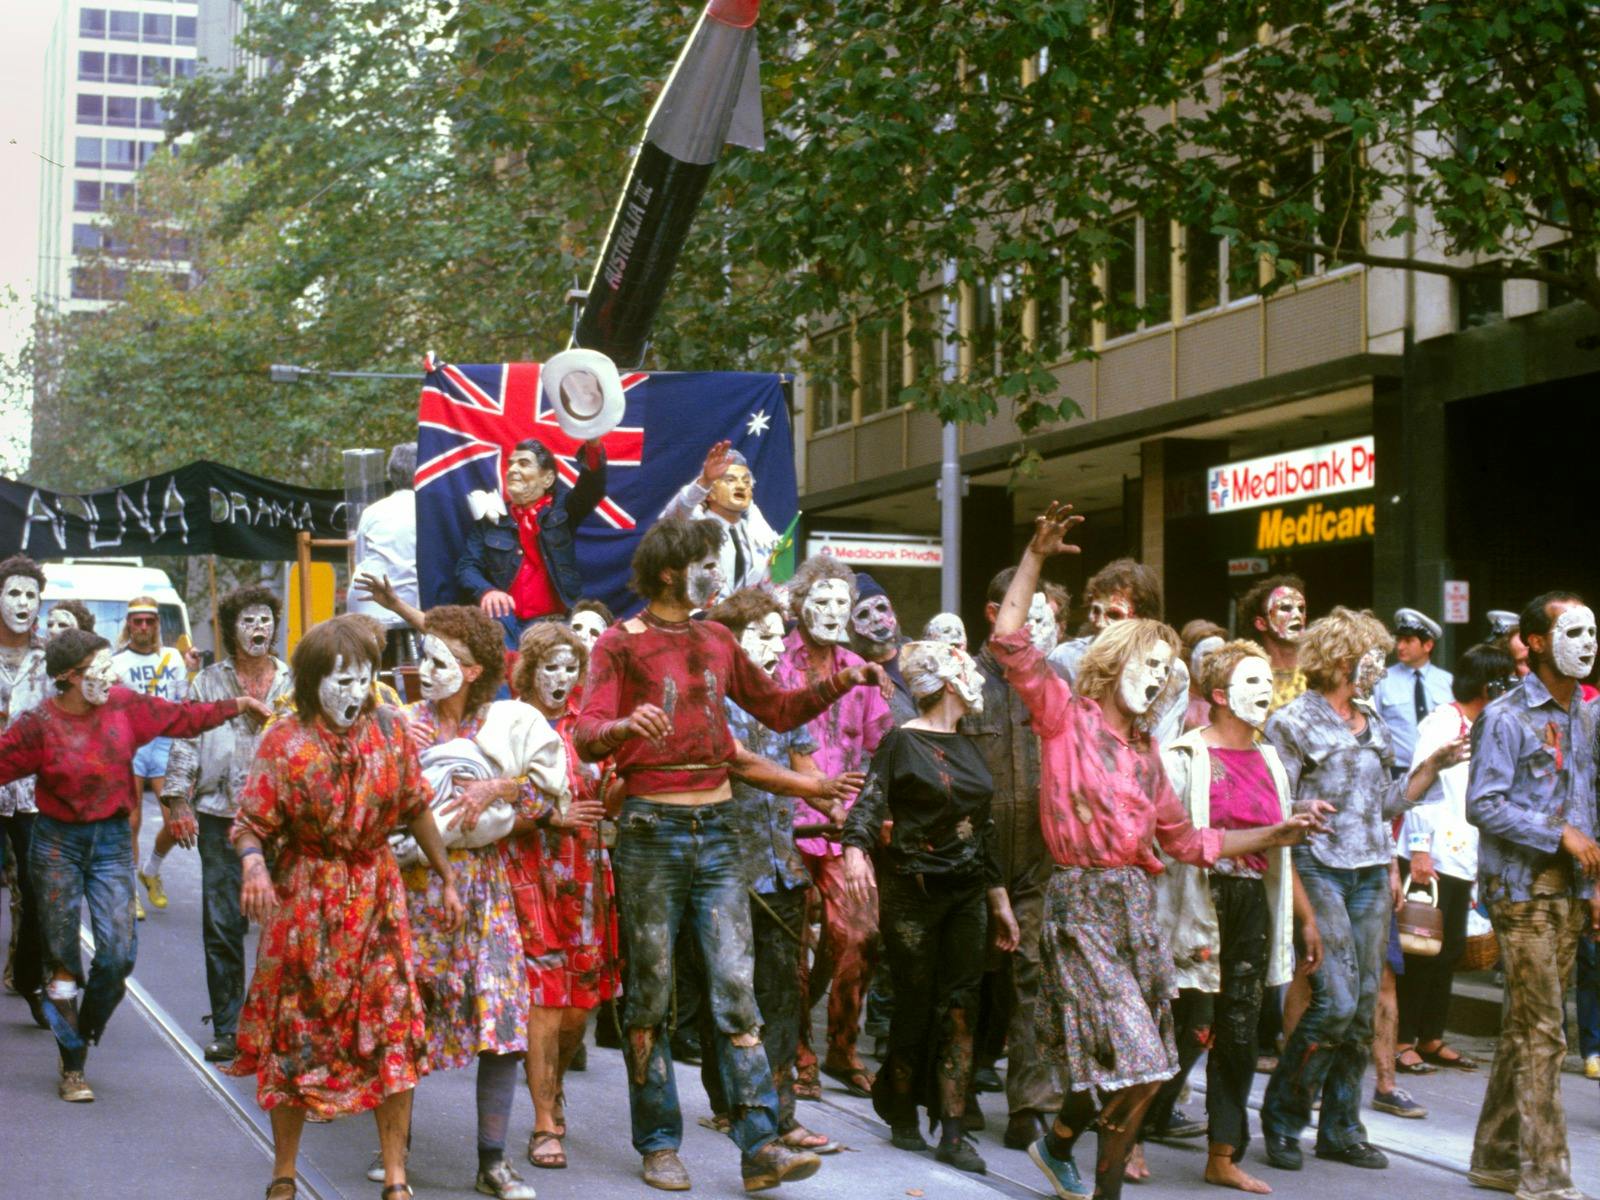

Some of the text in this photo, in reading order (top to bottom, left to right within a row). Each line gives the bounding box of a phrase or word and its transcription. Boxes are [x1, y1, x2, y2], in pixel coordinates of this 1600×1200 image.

[604, 202, 646, 291] AUSTRALIA
[1232, 450, 1347, 504] Medibank
[208, 486, 316, 531] DRAMA
[835, 546, 942, 562] Medibank Private
